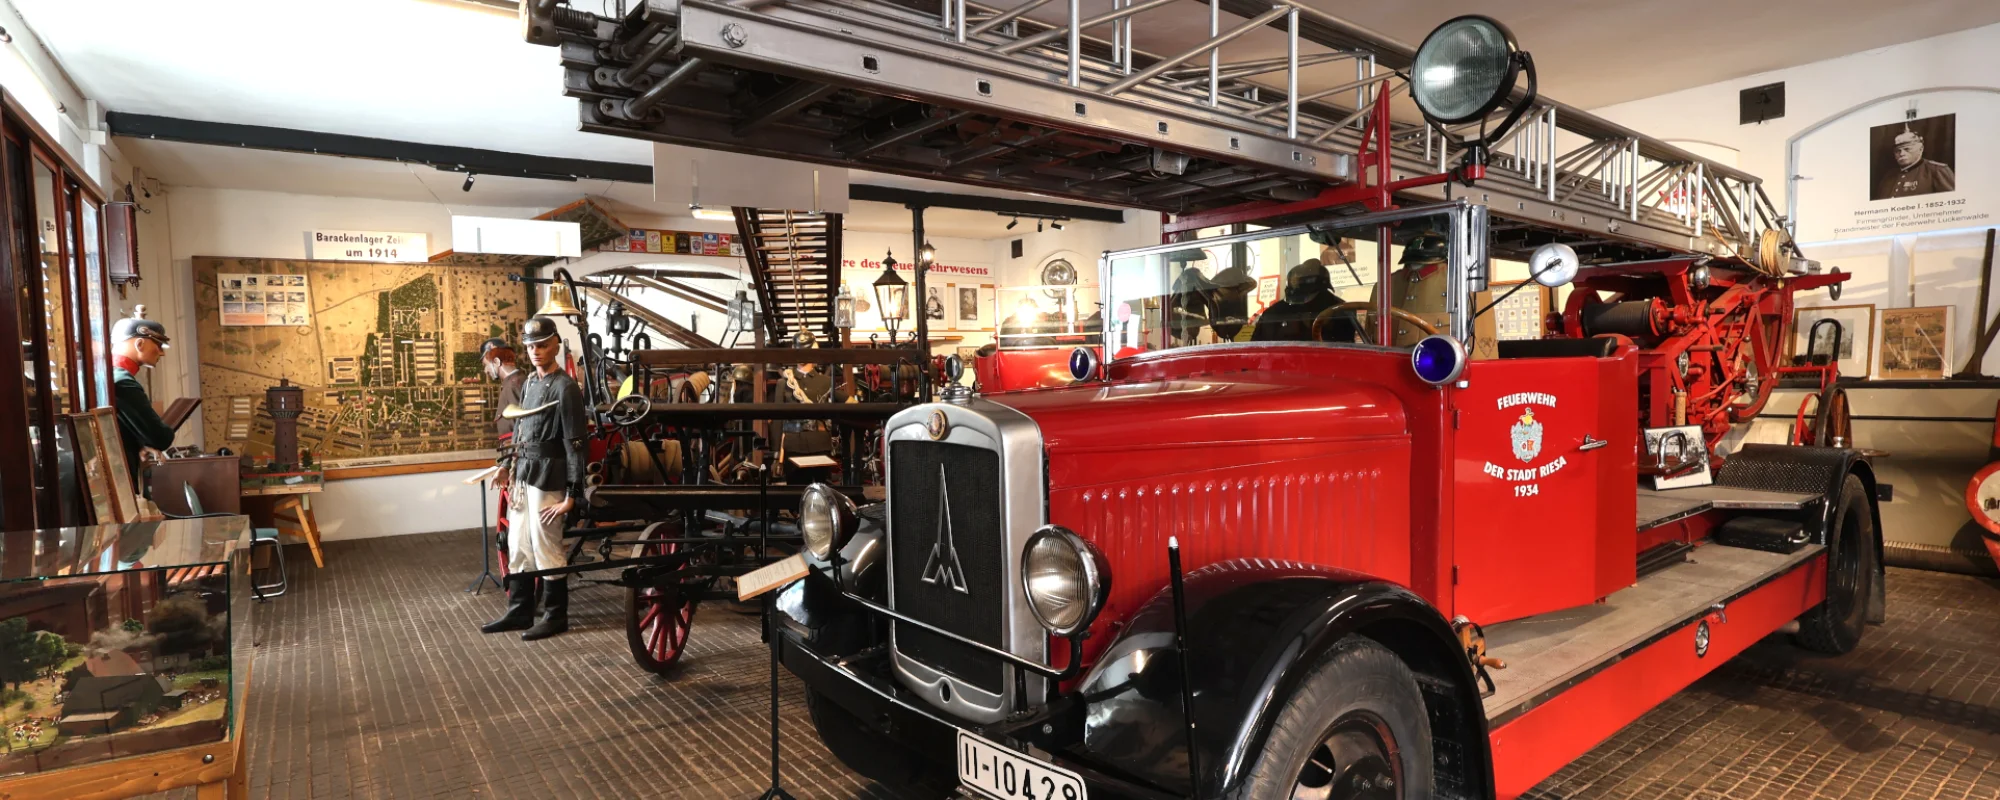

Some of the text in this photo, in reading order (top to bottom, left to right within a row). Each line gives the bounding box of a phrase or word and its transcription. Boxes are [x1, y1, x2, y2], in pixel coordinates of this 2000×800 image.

[1854, 207, 1889, 216] Hermann
[1891, 204, 1916, 212] Koebe
[1925, 198, 1966, 208] 1852-1932
[1913, 209, 1963, 219] Unternehmer
[1834, 224, 1880, 233] Brandmeister
[1896, 218, 1936, 228] Feuerwehr
[316, 232, 384, 246] Barackenlager
[346, 248, 397, 258] um 1914
[860, 258, 881, 270] des
[1497, 392, 1556, 410] FEUERWEHR
[1484, 456, 1567, 481] DER STADT RIESA
[1514, 484, 1538, 497] 1934
